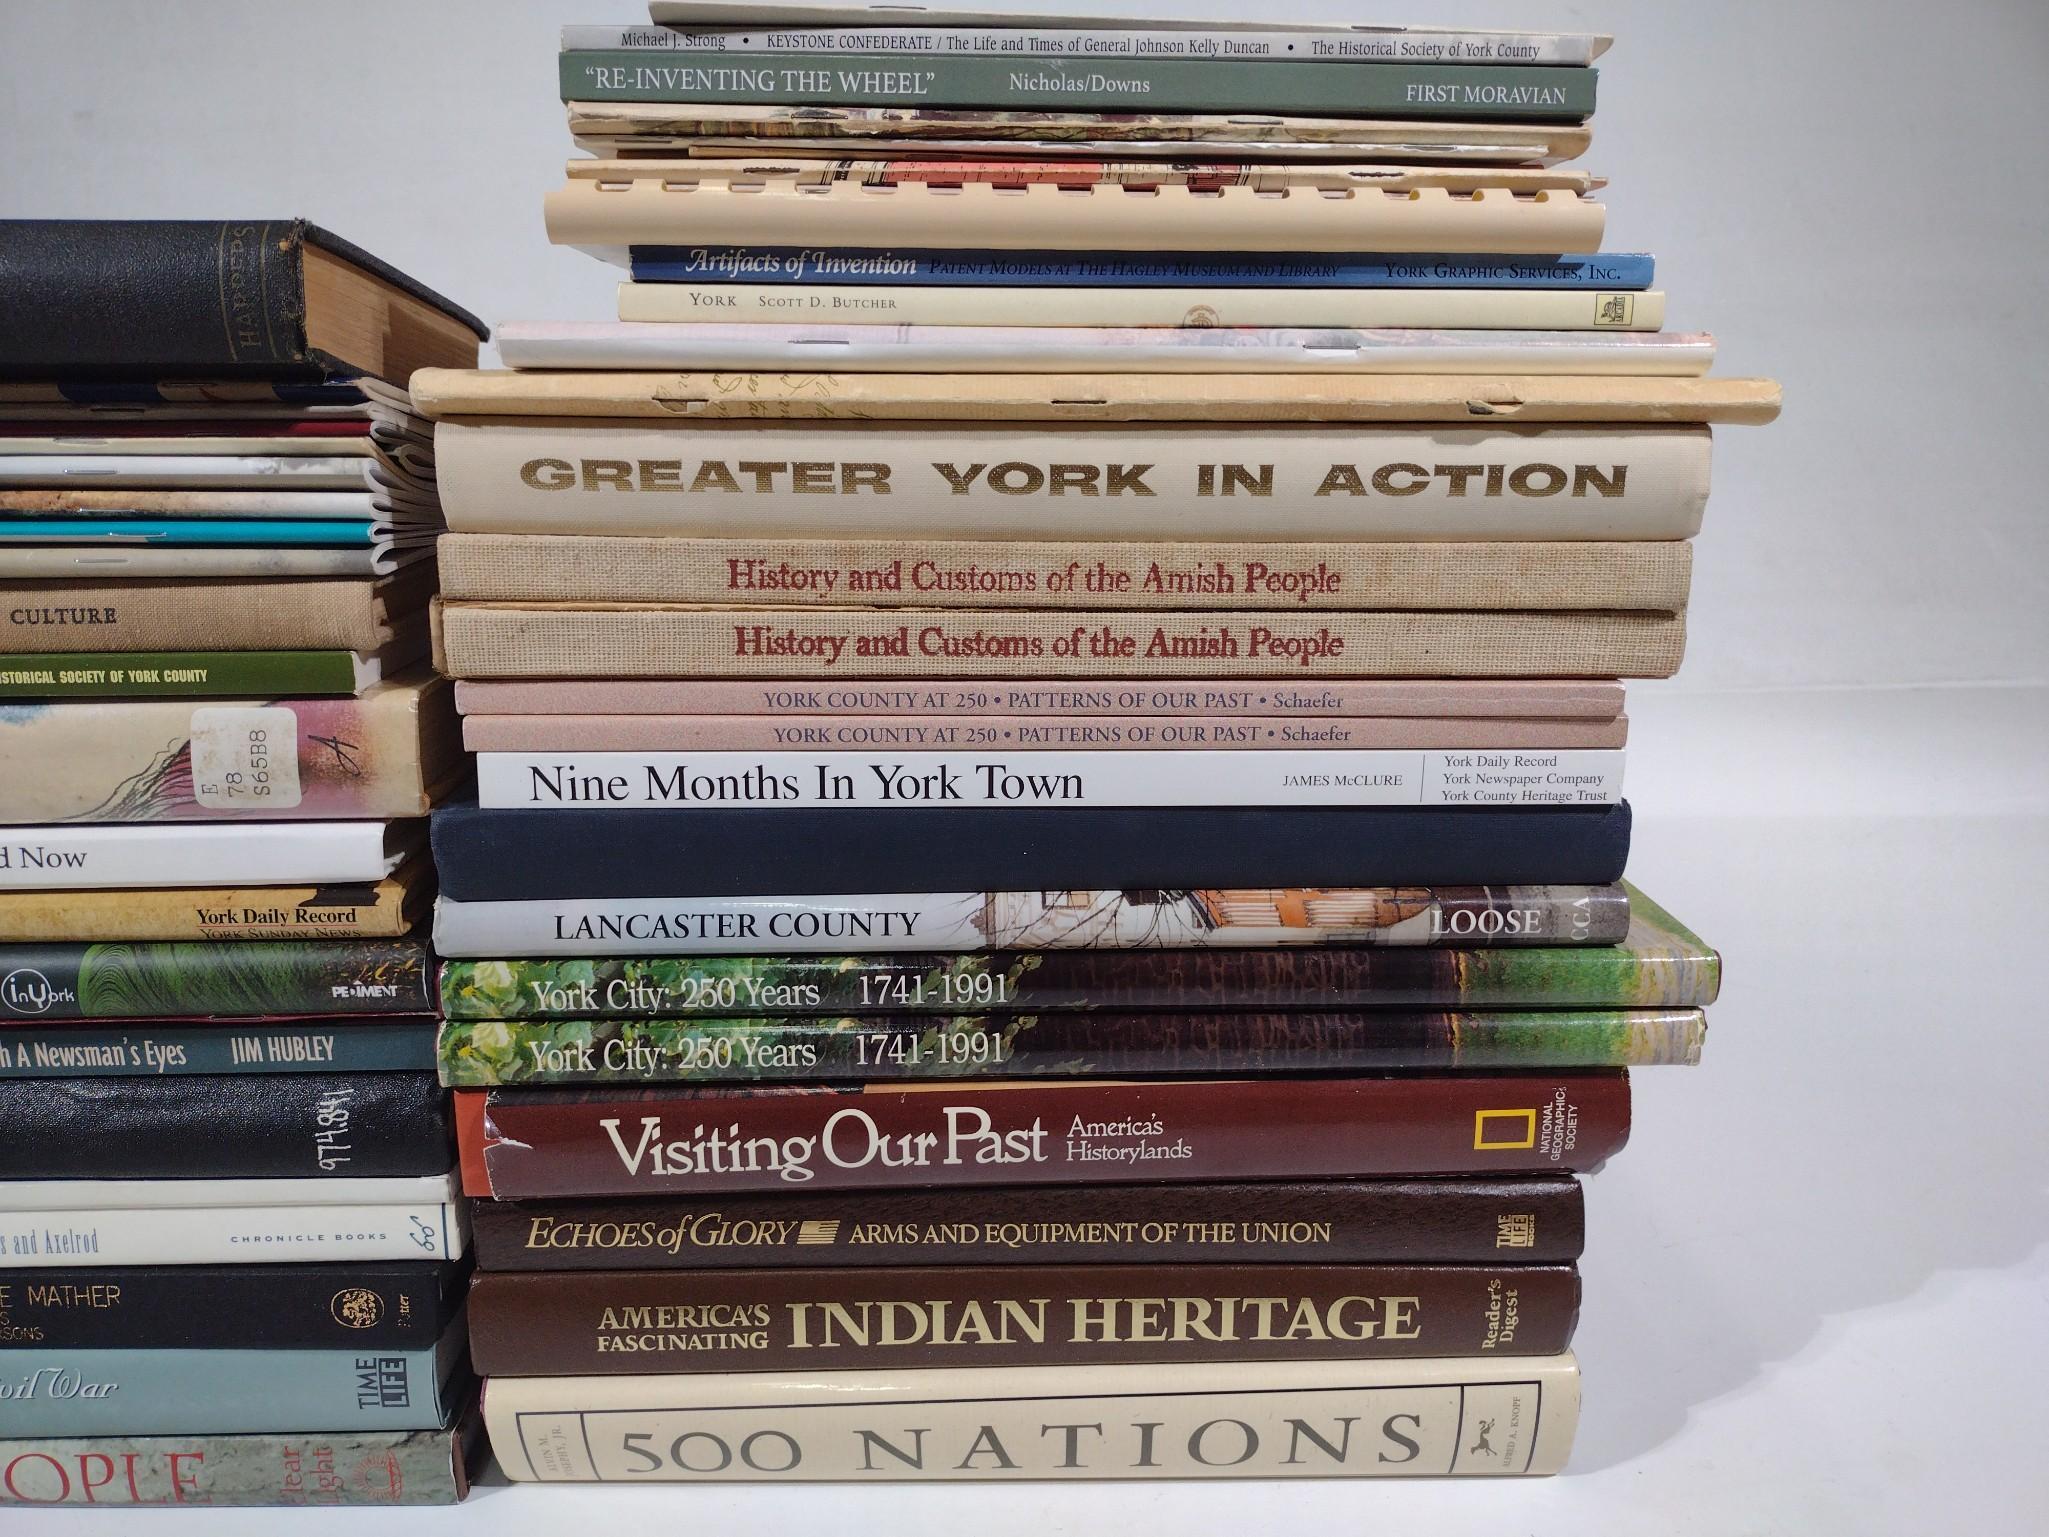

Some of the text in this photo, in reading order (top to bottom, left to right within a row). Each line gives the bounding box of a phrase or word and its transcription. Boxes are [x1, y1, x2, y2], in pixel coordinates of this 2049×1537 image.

[621, 32, 1540, 61] Michael J. Strong KEYSTONE CONFEDERATE The Life and Times of General Johnson Kelly Duncan The Historical Society of York County
[780, 70, 832, 93] THE
[1008, 72, 1151, 94] Nicholas/Downs
[1405, 83, 1460, 103] FIRST
[1464, 85, 1567, 105] MORAVIAN
[685, 249, 780, 274] Artifacts
[785, 250, 803, 279] of
[811, 250, 917, 276] Invention
[929, 259, 988, 276] PATENT
[990, 260, 1053, 277] MODELS
[1077, 260, 1110, 277] THE
[1112, 260, 1170, 278] HAGLEY
[1174, 261, 1239, 278] MUSEUM
[1243, 264, 1277, 278] AND
[1279, 261, 1341, 280] LIBRARY
[1384, 262, 1428, 279] YORK
[1433, 263, 1504, 280] GRAPHIC
[1509, 263, 1583, 281] SERVICES,
[1588, 264, 1621, 281] INC.
[688, 292, 898, 311] YORK SCOTT D. BUTCHER
[520, 458, 1629, 499] GREATER YORK IN ACTION
[727, 557, 1341, 603] History and Customs of the Amish People
[10, 607, 118, 626] CULTURE
[60, 671, 105, 684] SOCIETY
[110, 671, 124, 683] OF
[128, 670, 160, 683] YORK
[164, 669, 208, 683] COUNTY
[763, 691, 1344, 710] YORK COUNTY AT 250 PATTERNS OF OUR PAST Schaefer
[1443, 754, 1557, 772] York Daily Record
[201, 783, 219, 795] E
[225, 771, 245, 798] 78
[528, 764, 1403, 802] Nine Months In York Town JAMES McCLURE
[1443, 772, 1605, 788] York Newspaper Company
[1441, 788, 1608, 805] York County Heritage Trust
[20, 846, 88, 869] Now
[196, 907, 357, 927] York Daily Record
[554, 909, 1543, 941] LANCASTER COUNTY LOOSE
[531, 973, 1009, 1014] York City: 250 Years 1741-1991
[17, 1042, 32, 1067] A
[145, 1038, 187, 1073] Eyes
[231, 1037, 265, 1065] JIM
[268, 1035, 334, 1063] HUBLEY
[1067, 1113, 1164, 1138] America's
[1540, 1101, 1553, 1153] NATIONAL
[1550, 1091, 1566, 1161] GEOGRAPHIC
[1565, 1104, 1578, 1150] SOCIETY
[600, 1106, 1049, 1182] Visiting Our Past
[1066, 1139, 1193, 1163] Historylands
[13, 1228, 38, 1254] and
[45, 1228, 99, 1254] Axelrod
[230, 1233, 326, 1244] CHRONICLE
[334, 1232, 388, 1242] BOOKS
[525, 1213, 1332, 1255] ECHOES of GLORY ARMS AND EQUIPMENT OF THE UNION
[1496, 1214, 1512, 1249] TIME
[1510, 1214, 1528, 1247] LIFE
[27, 1285, 121, 1308] MATHER
[786, 1296, 1421, 1349] INDIAN HERITAGE
[1501, 1289, 1520, 1343] Digest
[597, 1331, 769, 1353] FASCINATING
[48, 1368, 120, 1400] War
[355, 1357, 378, 1410] TIME
[379, 1357, 410, 1408] LIFE
[622, 1429, 803, 1474] 500
[854, 1413, 1422, 1473] NATIONS
